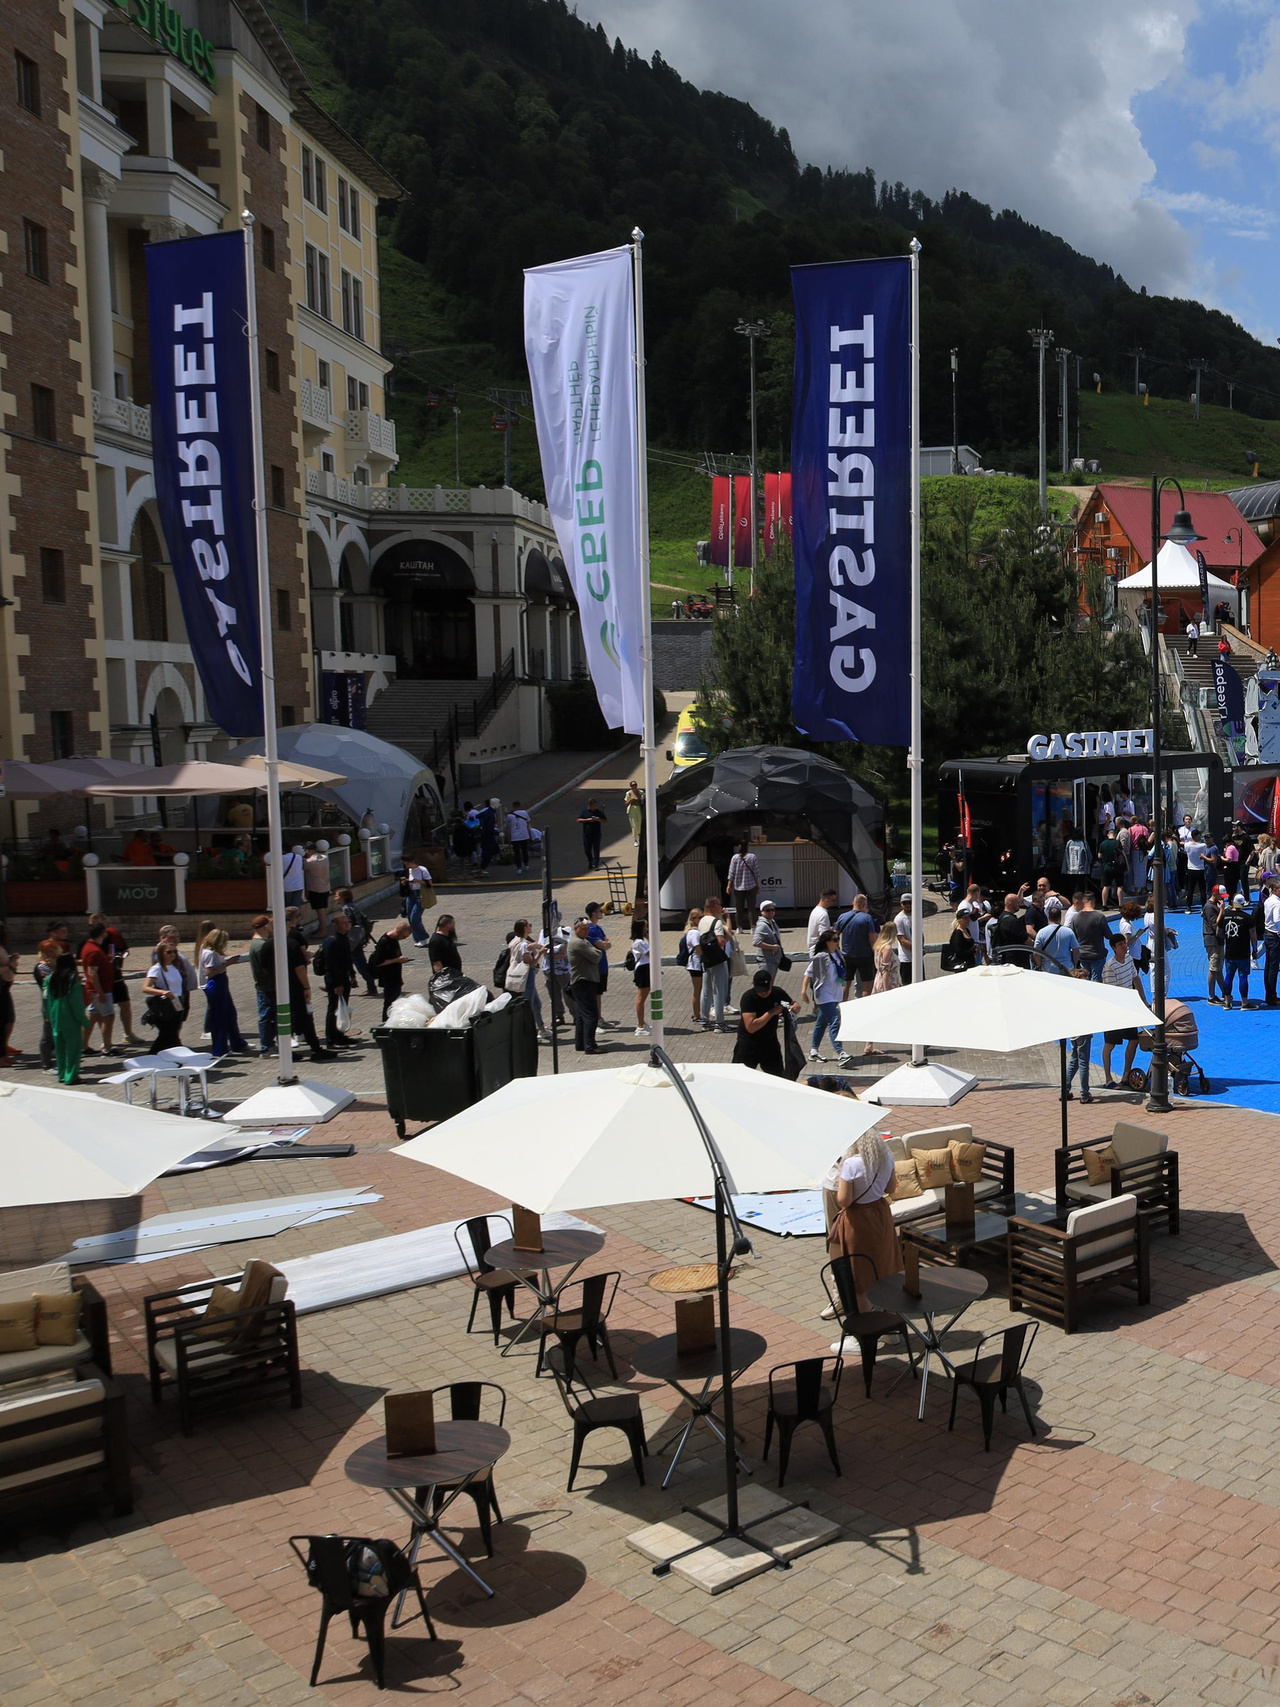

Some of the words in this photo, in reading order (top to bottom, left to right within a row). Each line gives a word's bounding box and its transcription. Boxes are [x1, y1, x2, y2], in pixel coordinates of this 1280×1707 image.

[399, 560, 434, 570] КАШТАН
[1027, 729, 1154, 760] GASTREET
[761, 876, 782, 886] сбп
